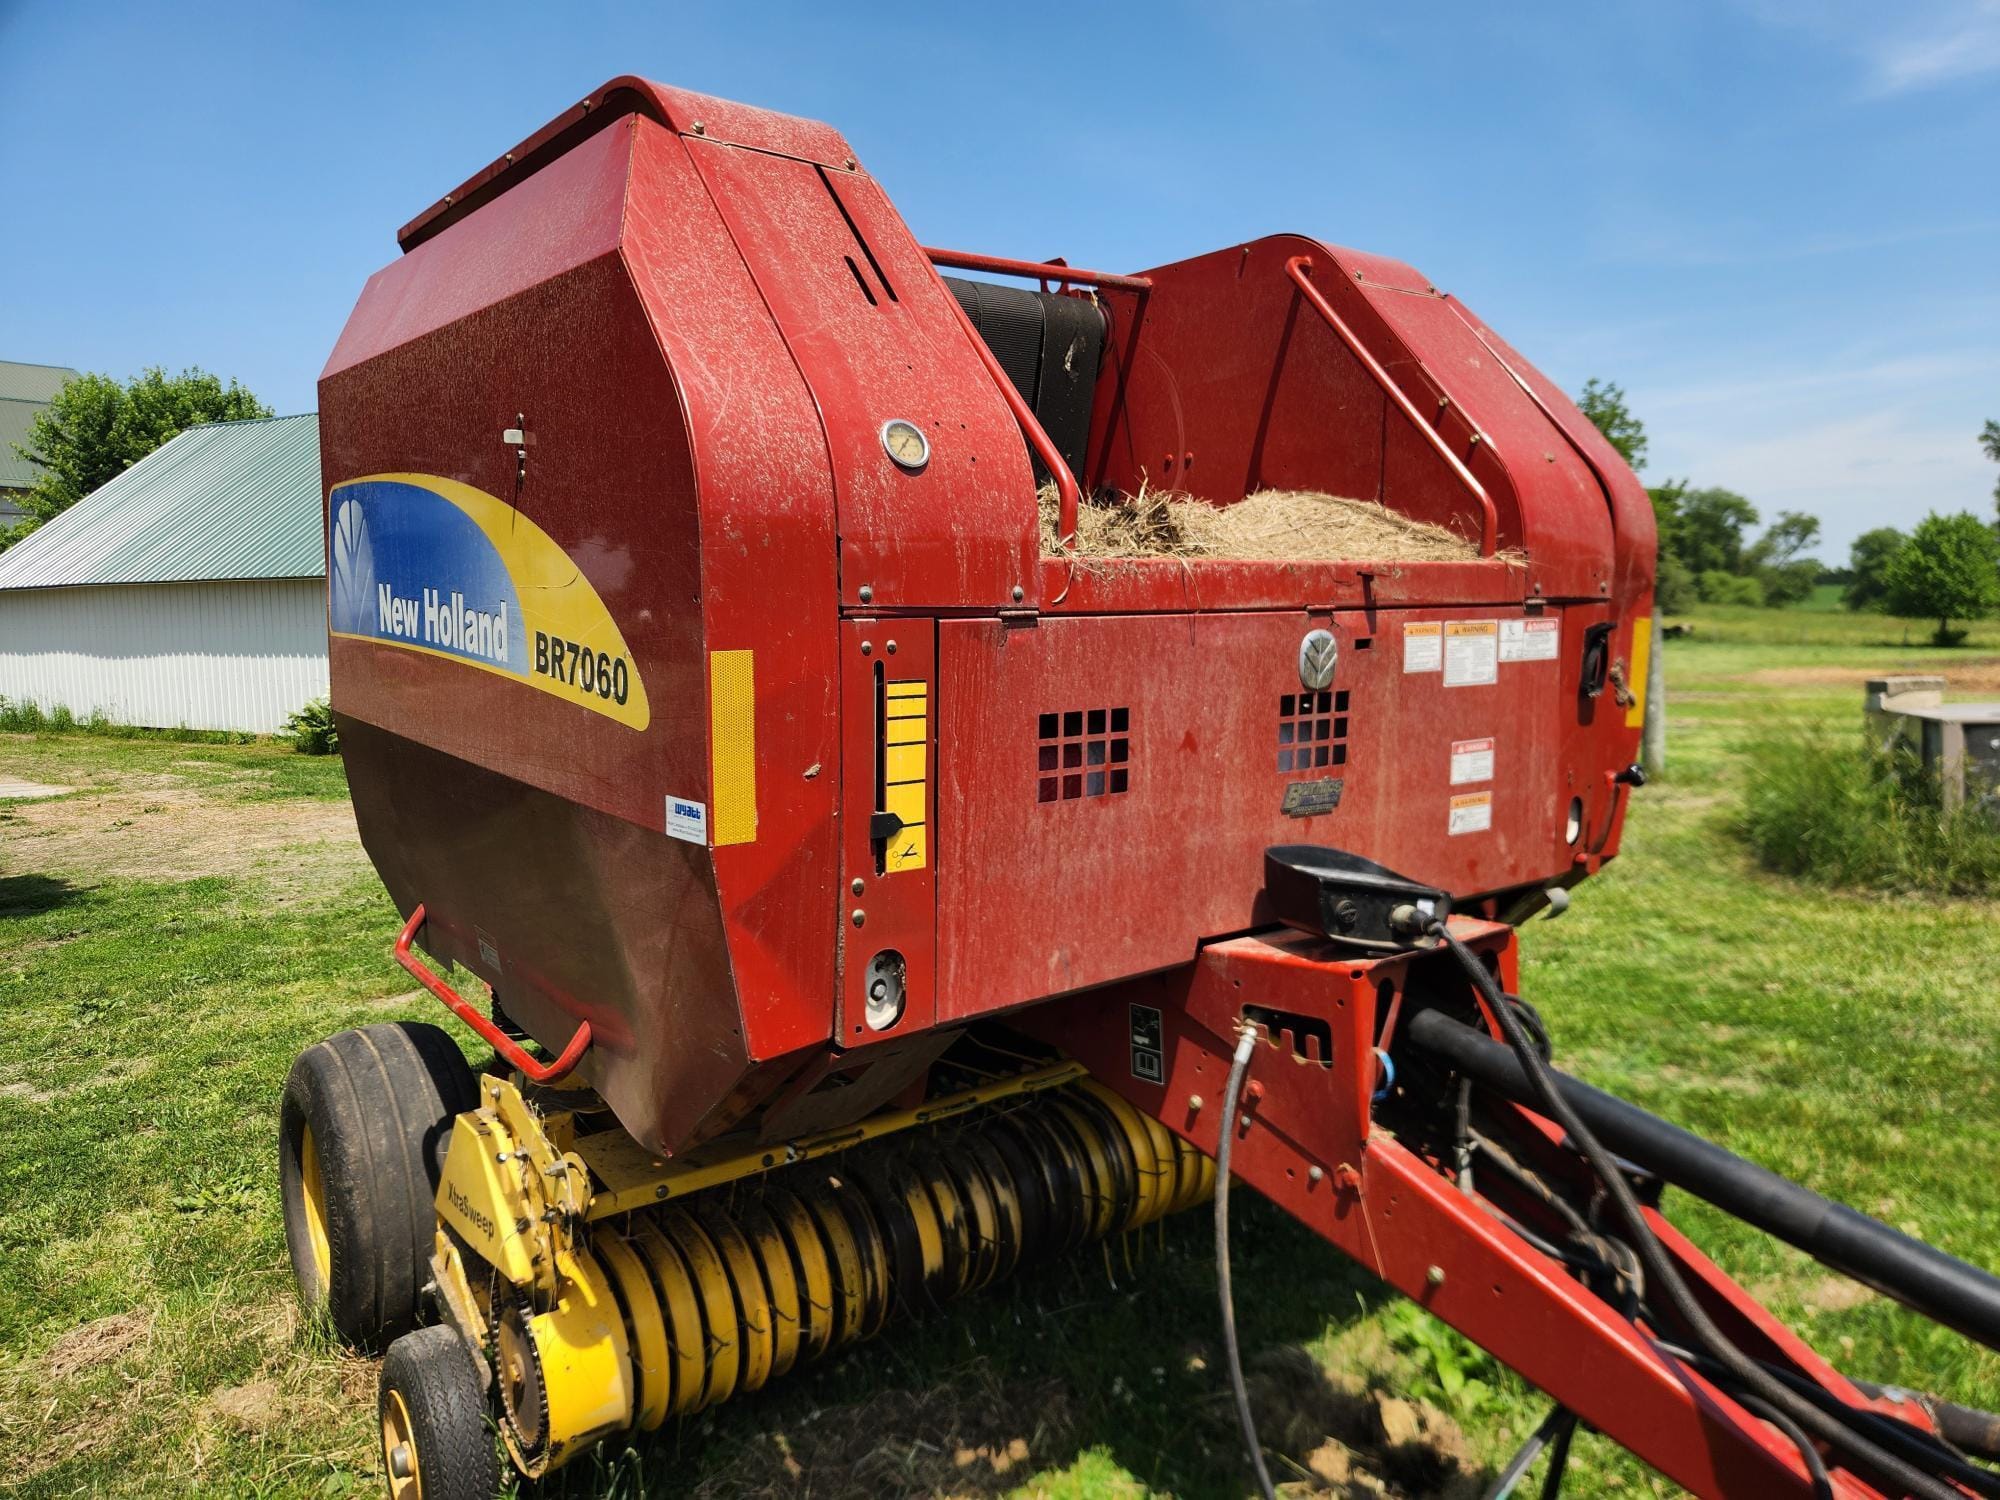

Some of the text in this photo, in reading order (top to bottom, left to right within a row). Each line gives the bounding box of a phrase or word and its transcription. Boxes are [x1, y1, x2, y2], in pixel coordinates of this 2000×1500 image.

[378, 583, 508, 662] New Holland
[1462, 621, 1488, 632] WARNING
[534, 630, 629, 706] BR7060
[448, 1180, 495, 1242] XtraSweep
